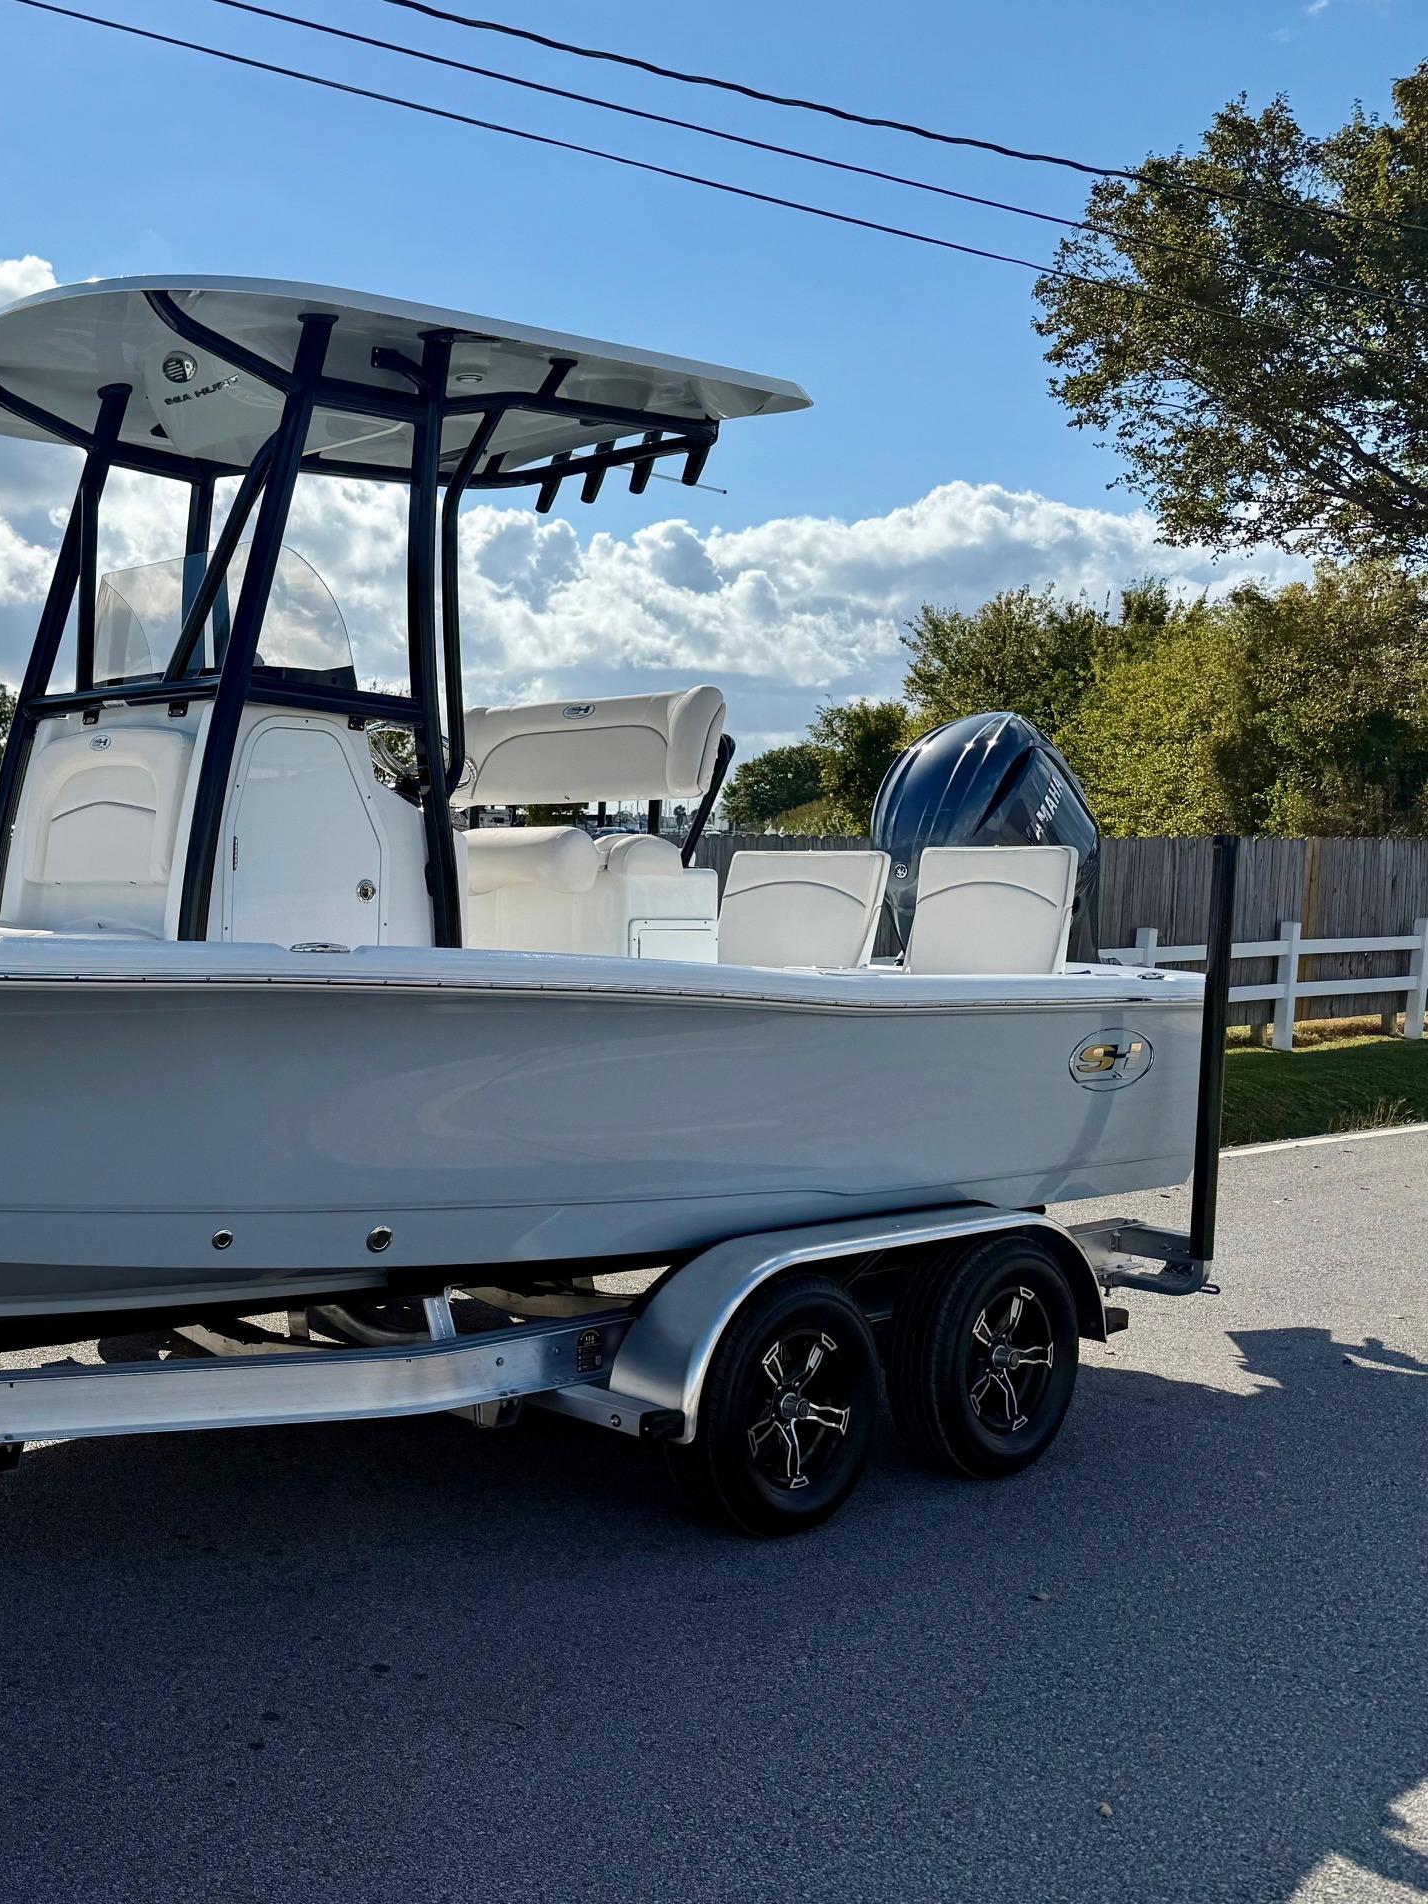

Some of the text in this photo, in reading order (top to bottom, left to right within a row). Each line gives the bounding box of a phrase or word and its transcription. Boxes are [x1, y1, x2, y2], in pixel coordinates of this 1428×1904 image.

[164, 373, 240, 406] SEA HUNT
[1021, 774, 1064, 846] YAMAHA
